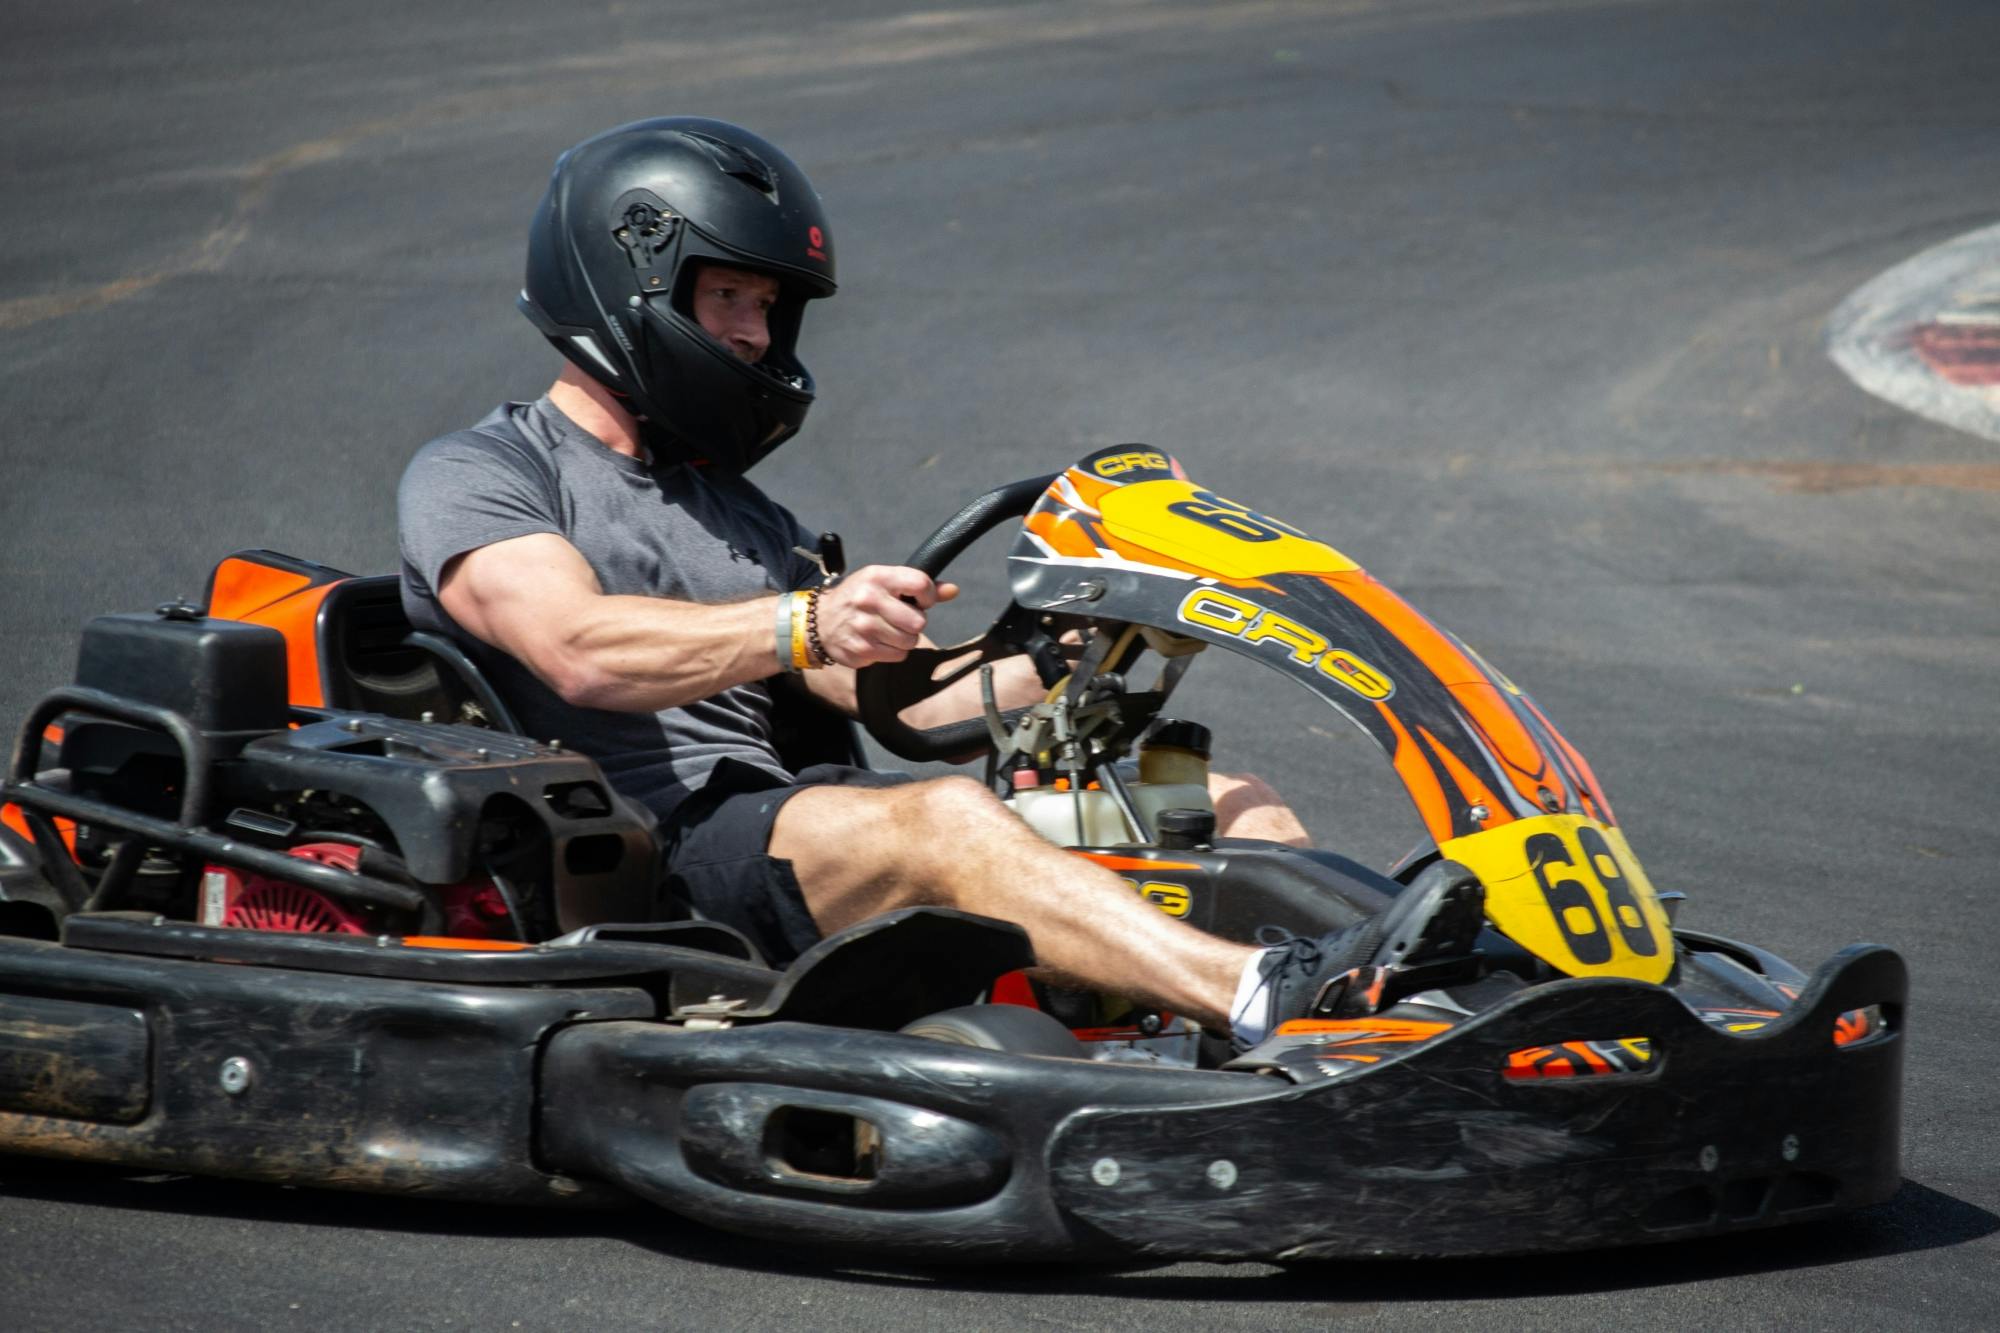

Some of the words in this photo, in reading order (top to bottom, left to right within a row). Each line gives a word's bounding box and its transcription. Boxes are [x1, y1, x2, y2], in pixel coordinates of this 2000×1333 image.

[1094, 452, 1169, 477] CRG
[1177, 587, 1396, 701] CRG
[1525, 826, 1657, 965] 68
